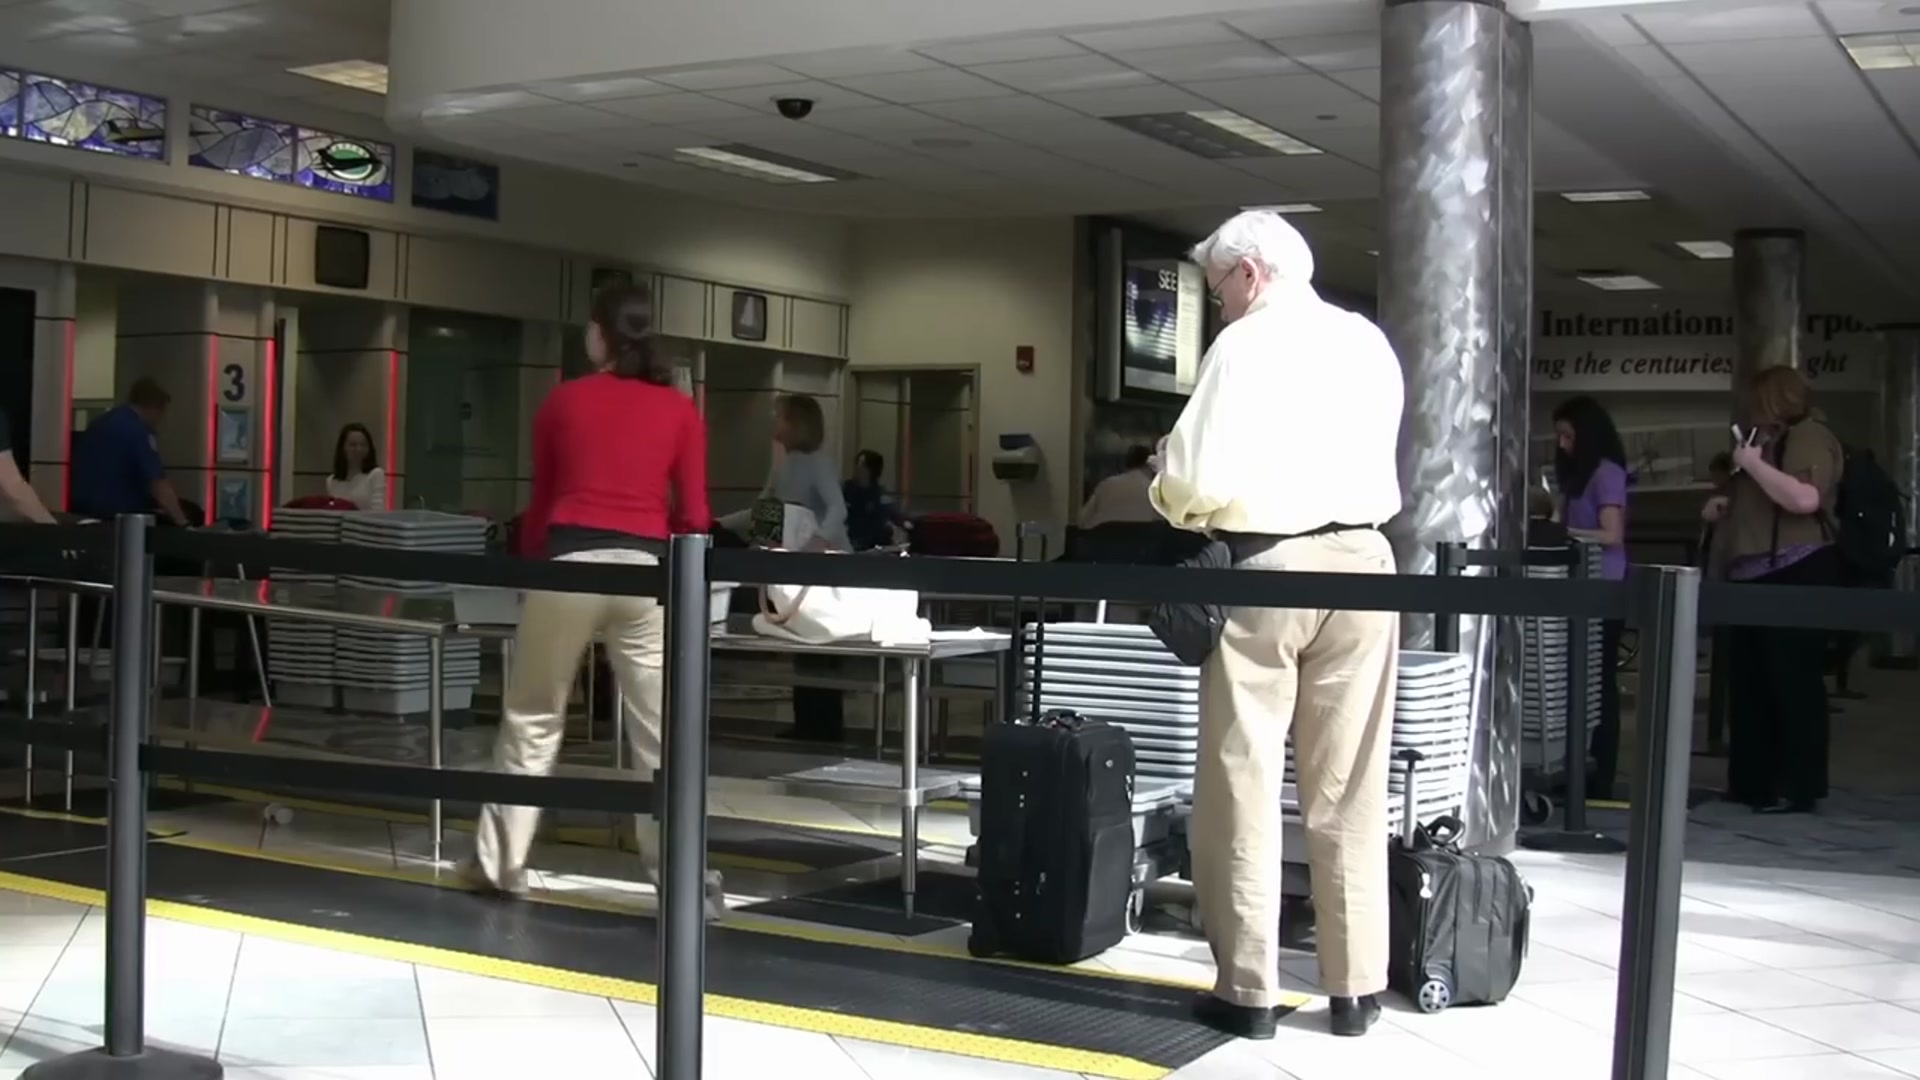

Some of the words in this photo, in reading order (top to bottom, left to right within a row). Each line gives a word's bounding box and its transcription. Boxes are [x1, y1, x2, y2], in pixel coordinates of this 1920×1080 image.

[1541, 308, 1733, 337] Internation
[1574, 352, 1612, 374] the
[1620, 352, 1733, 375] centuries
[224, 363, 245, 402] 3
